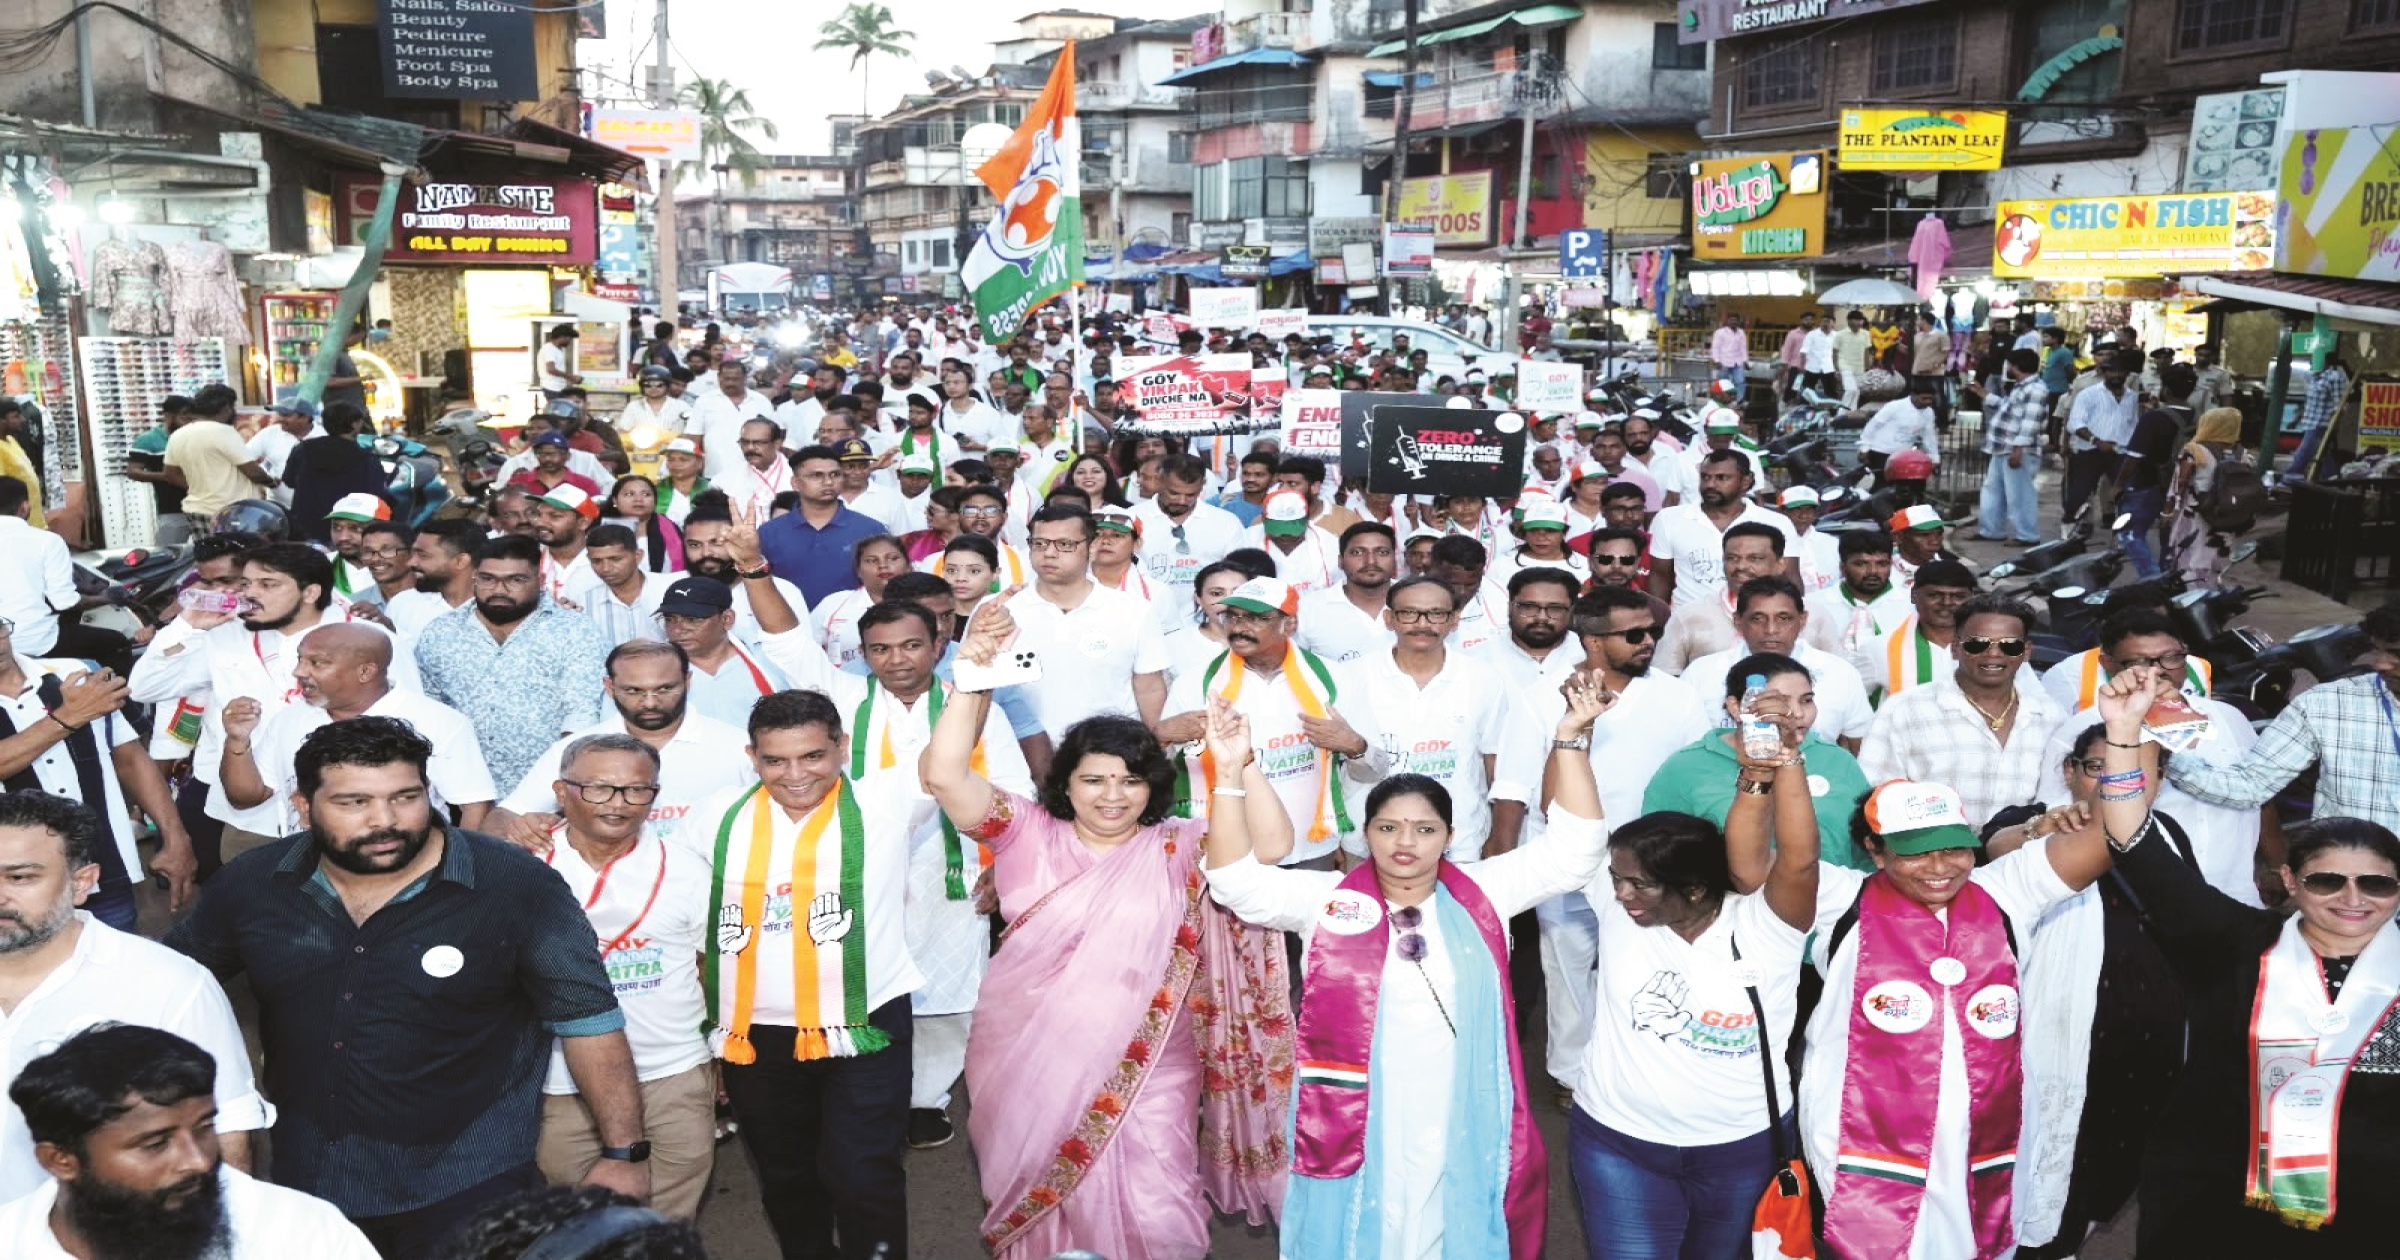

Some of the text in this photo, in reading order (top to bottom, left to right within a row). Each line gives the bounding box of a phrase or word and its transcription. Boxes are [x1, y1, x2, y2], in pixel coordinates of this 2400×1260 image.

[391, 13, 467, 29] Beauty
[1732, 0, 1828, 32] RESTAURANT
[392, 28, 487, 43] Pedicure
[394, 44, 493, 58] Menicure
[396, 59, 492, 75] Foot Spa
[397, 74, 499, 91] Body Spa
[1844, 133, 2002, 147] THE PLANTAIN LEAF
[1693, 160, 1773, 219] Udupi
[416, 183, 555, 214] NAMASTE
[402, 212, 571, 231] Family Restaurant
[2049, 197, 2232, 230] CHIC N FISH
[410, 236, 448, 250] ALL
[1568, 231, 1591, 258] P
[1742, 227, 1804, 254] KITCHEN
[1139, 382, 1200, 397] VIKPAK
[1142, 392, 1207, 406] DIVCHE NA
[1417, 429, 1476, 444] ZERO
[1418, 443, 1504, 456] TOLERANCE
[1421, 453, 1504, 463] ON DRUGS & CRIME.
[1266, 751, 1315, 771] YATRA
[1411, 759, 1455, 773] YATRA
[608, 960, 663, 980] ATRA
